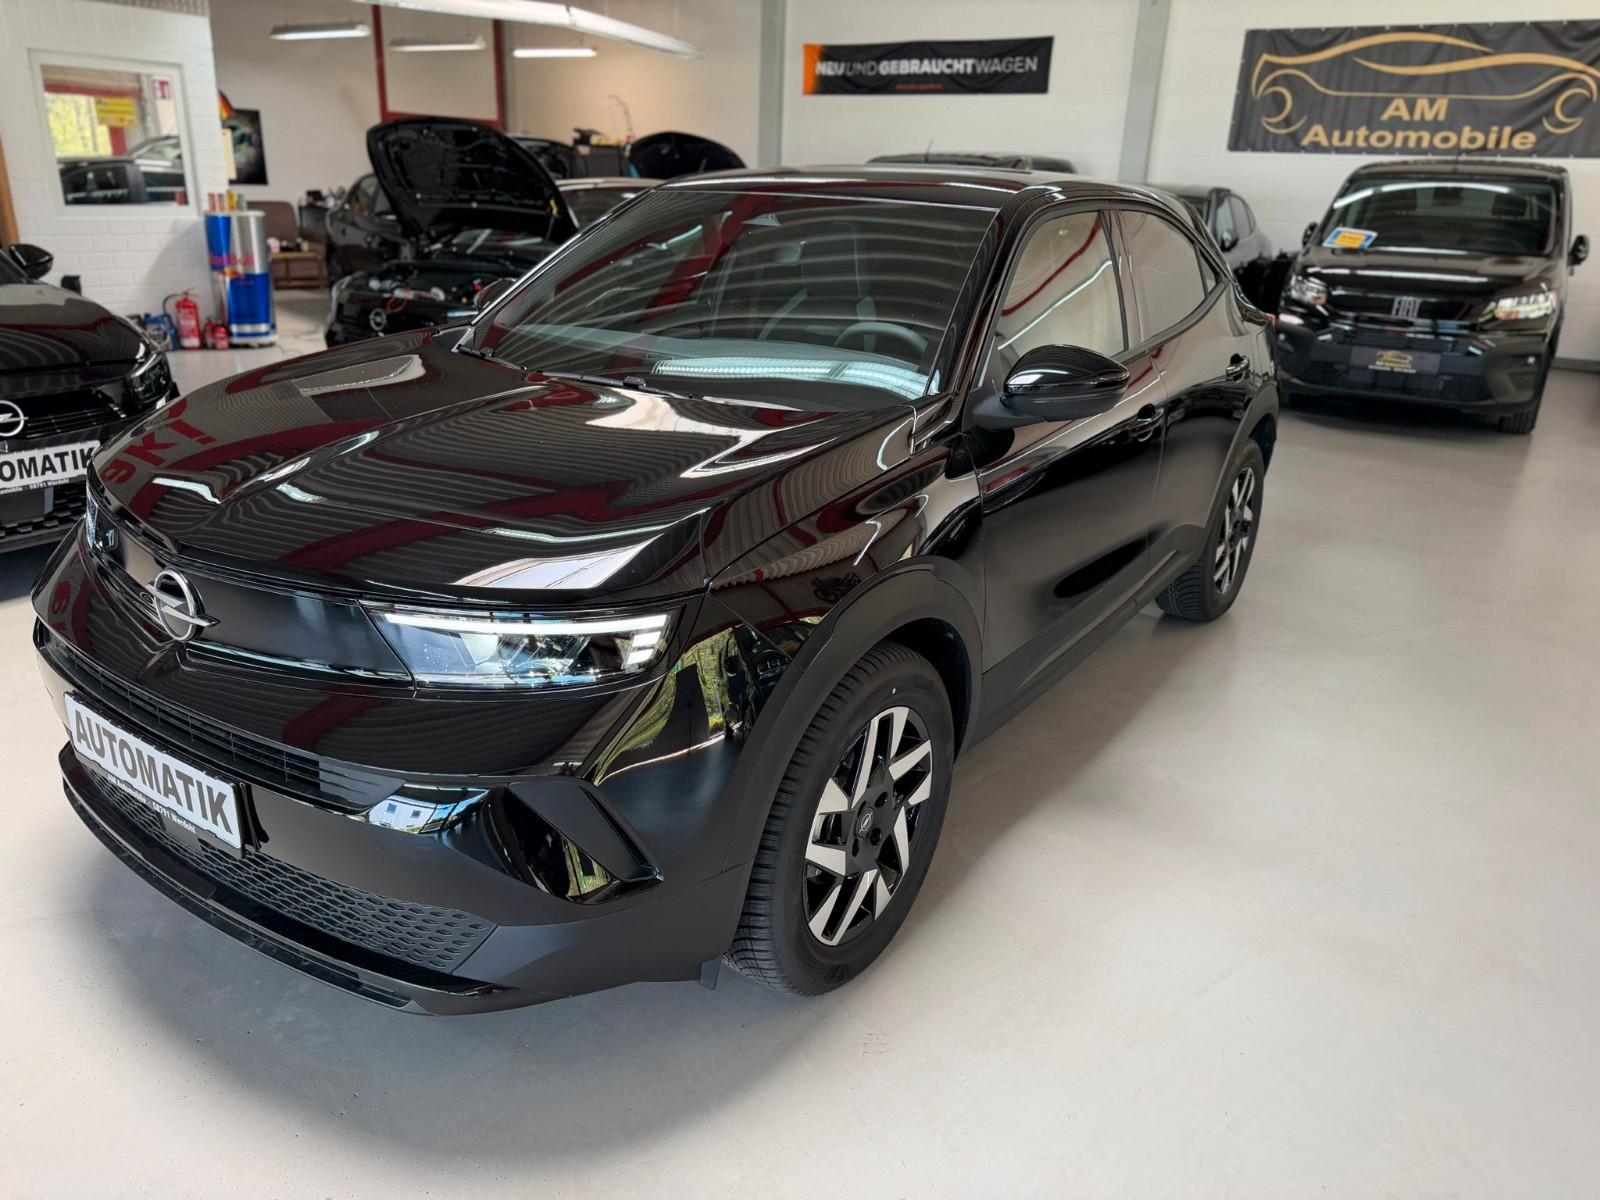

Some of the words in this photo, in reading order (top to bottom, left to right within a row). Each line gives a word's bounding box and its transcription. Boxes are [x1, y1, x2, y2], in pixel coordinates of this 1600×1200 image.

[1380, 97, 1450, 122] AM
[1300, 124, 1537, 150] Automobile
[1391, 295, 1422, 317] FIAT
[74, 708, 234, 836] AUTOMATIK
